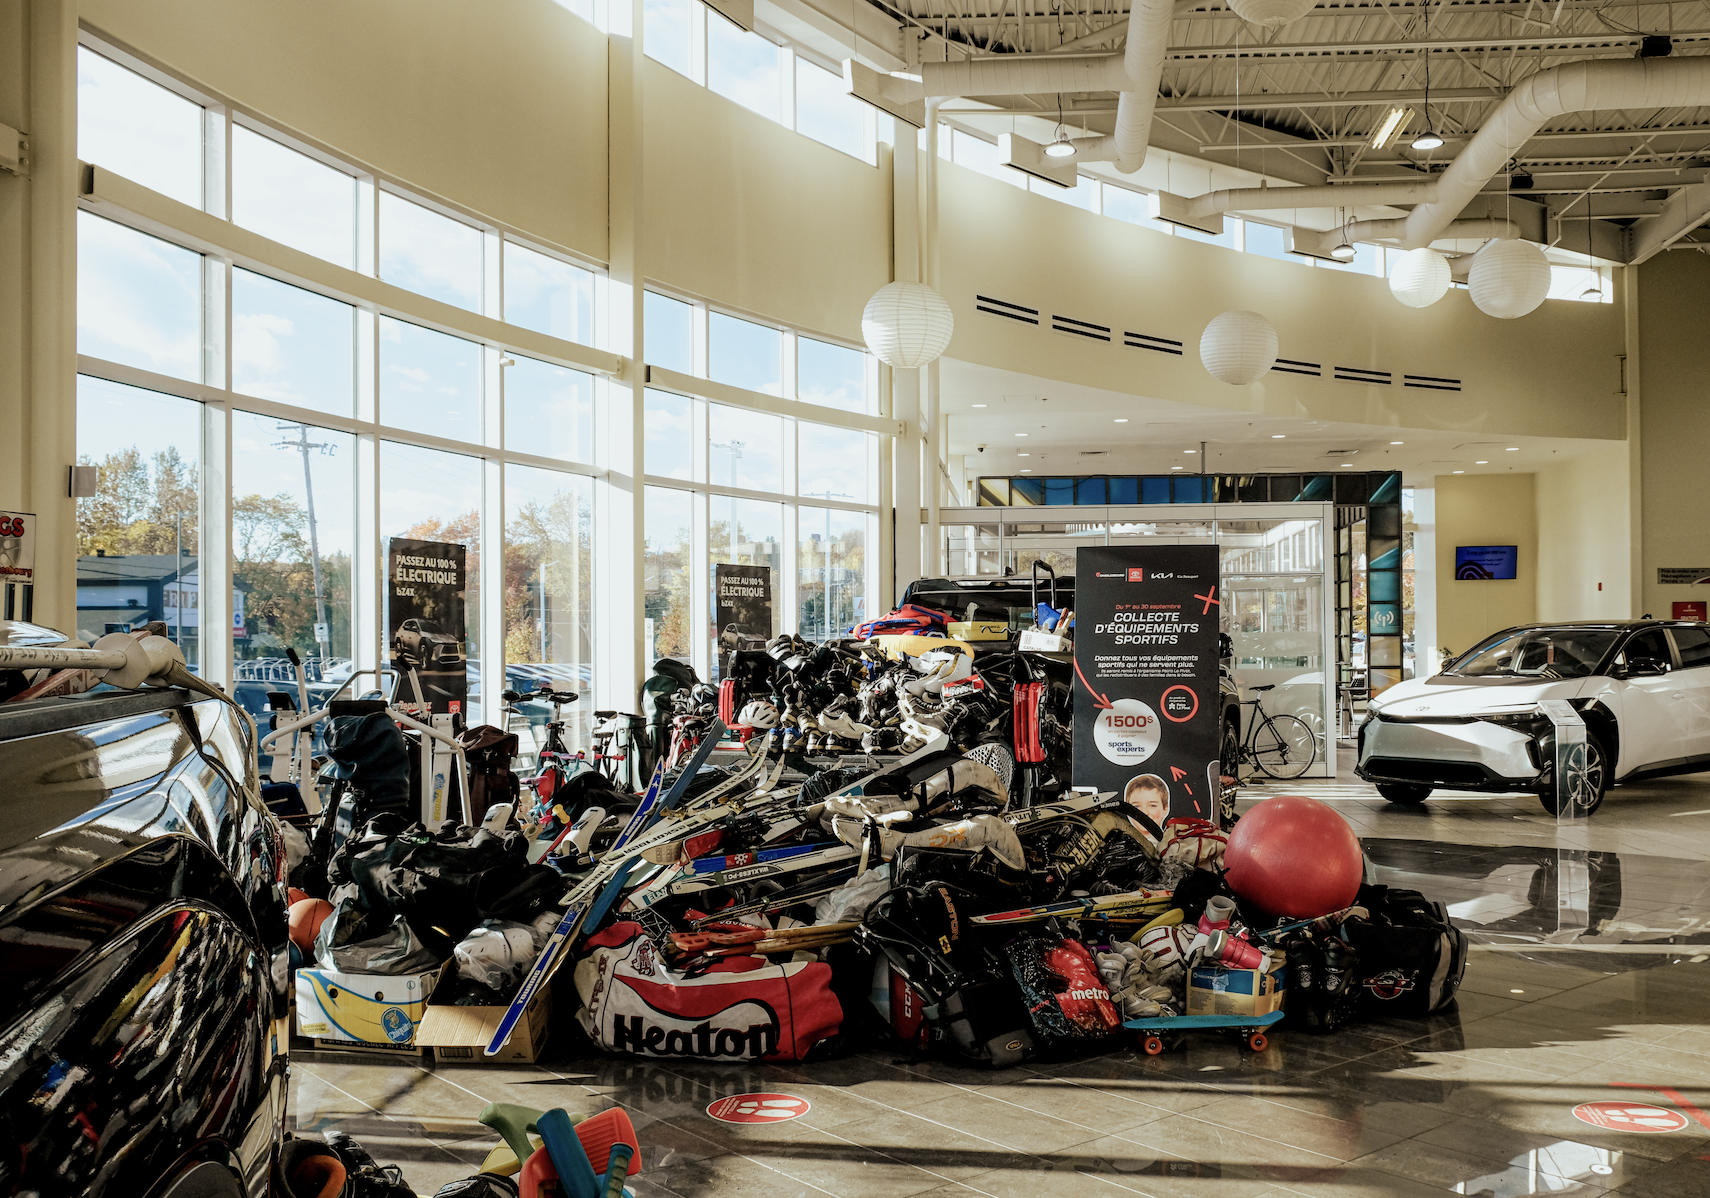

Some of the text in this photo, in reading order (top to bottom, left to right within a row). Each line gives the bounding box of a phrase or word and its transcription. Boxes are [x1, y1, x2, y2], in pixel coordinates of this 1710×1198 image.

[396, 554, 457, 570] PASSEZ AU 100 %
[396, 564, 457, 585] ÉLECTRIQUE
[720, 576, 740, 585] PASSEZ
[741, 577, 749, 585] AU
[720, 583, 765, 598] ÉLECTRIQUE
[1114, 612, 1180, 622] COLLECTE
[1095, 622, 1199, 634] D'ÉQUIPEMENTS
[1115, 635, 1178, 645] SPORTIFS
[1152, 654, 1199, 663] équipements
[1105, 715, 1153, 728] 1500$
[728, 866, 769, 880] WAXLESS-PC
[938, 887, 959, 941] EASTON
[517, 970, 541, 1005] TOURING
[1072, 987, 1110, 1001] metro
[904, 981, 913, 1019] CCM
[1030, 1000, 1050, 1014] metro
[388, 1021, 414, 1040] Chiquita
[613, 1013, 781, 1057] Heaton
